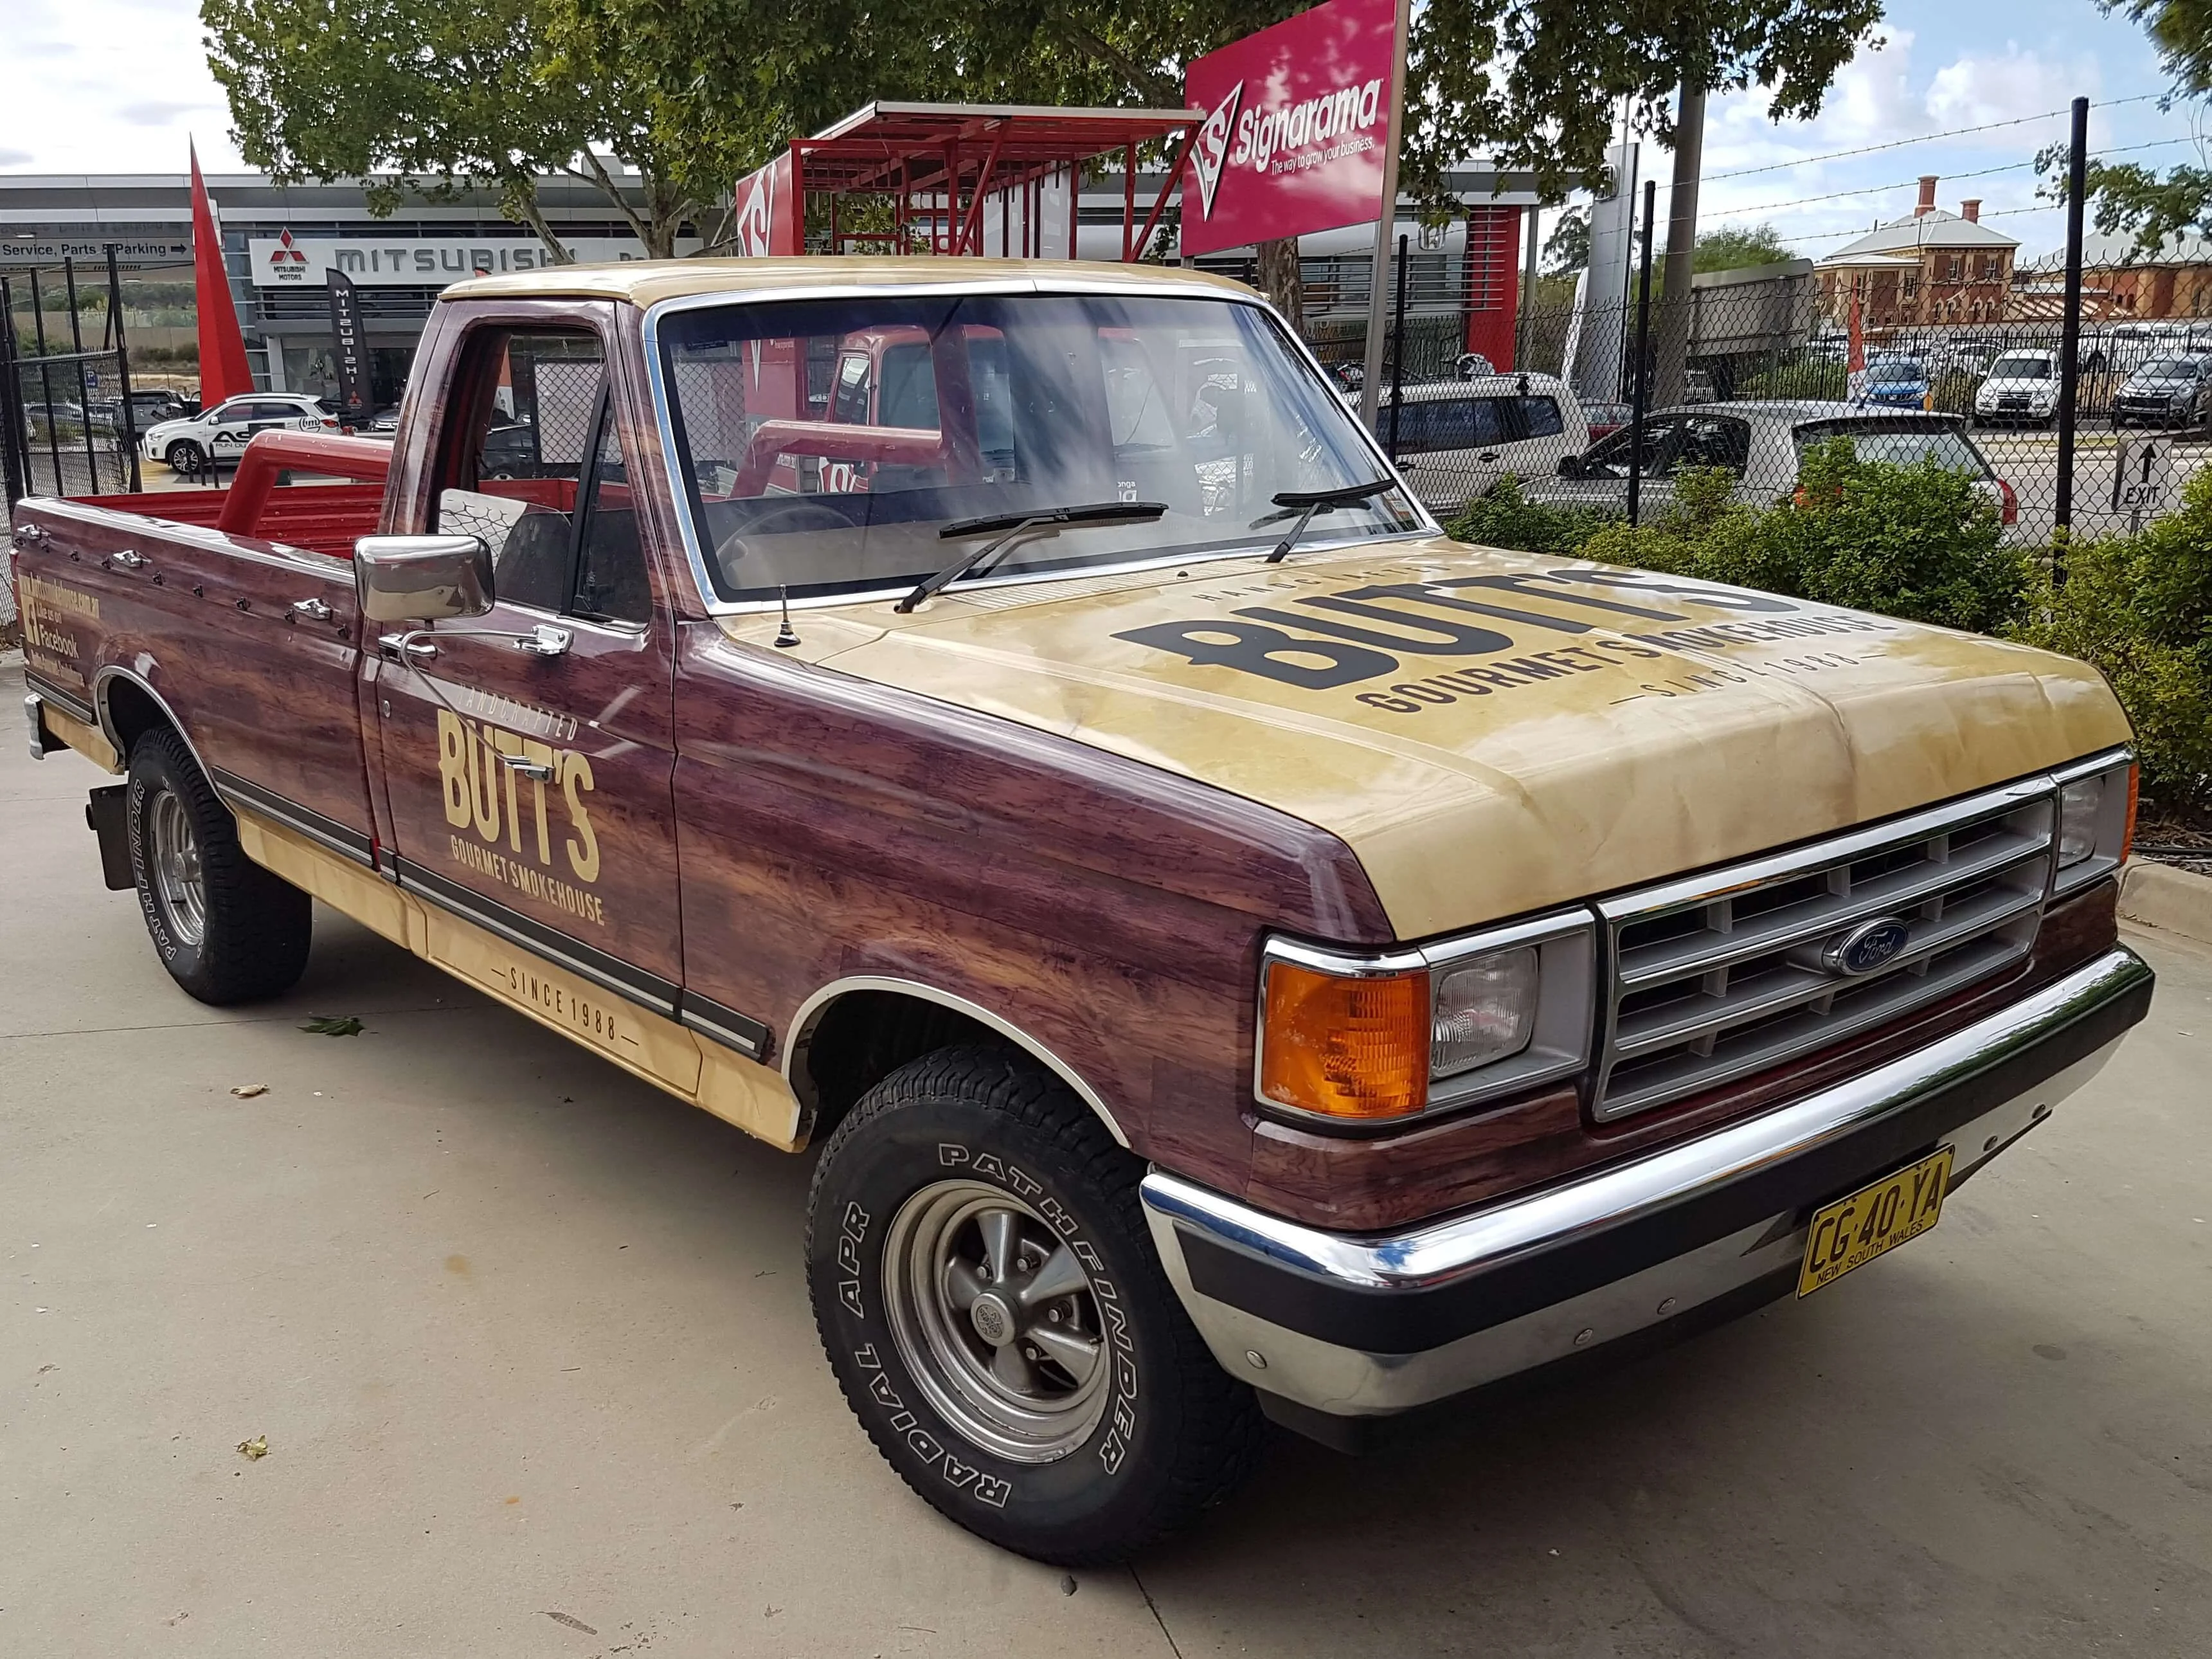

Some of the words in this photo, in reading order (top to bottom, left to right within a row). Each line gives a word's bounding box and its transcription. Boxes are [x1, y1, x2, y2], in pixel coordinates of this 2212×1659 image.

[1236, 78, 1381, 173] Signarama
[1271, 159, 1283, 175] The
[1283, 157, 1297, 174] way
[1297, 155, 1305, 168] to
[1306, 150, 1323, 170] grow
[1324, 145, 1340, 165] your
[1340, 136, 1375, 156] business.
[3, 244, 57, 257] Service,
[62, 244, 96, 255] Parts
[115, 243, 166, 257] Parking
[2124, 487, 2160, 503] EXIT
[39, 624, 80, 659] Facebook
[1354, 646, 1623, 713] GOURMET
[1594, 615, 1898, 658] SMOKEHOUSE
[1640, 663, 1768, 697] SINCE
[1763, 652, 1860, 675] 1988
[457, 683, 578, 741] HANDCRAFTED
[437, 707, 601, 882] BUTT'S
[130, 779, 177, 961] PATHFINDER
[451, 835, 508, 884] GOURMET
[509, 860, 605, 926] SMOKEHOUSE
[1858, 930, 1896, 964] Ford
[510, 966, 562, 1014] SINCE
[571, 997, 615, 1040] 1988
[838, 1201, 870, 1319] APR
[1815, 1262, 1842, 1286] NEW
[1846, 1238, 1885, 1269] SOUTH
[1889, 1219, 1924, 1246] WALES
[939, 1143, 1138, 1476] PATHFINDER
[854, 1343, 1014, 1508] RADIAL
